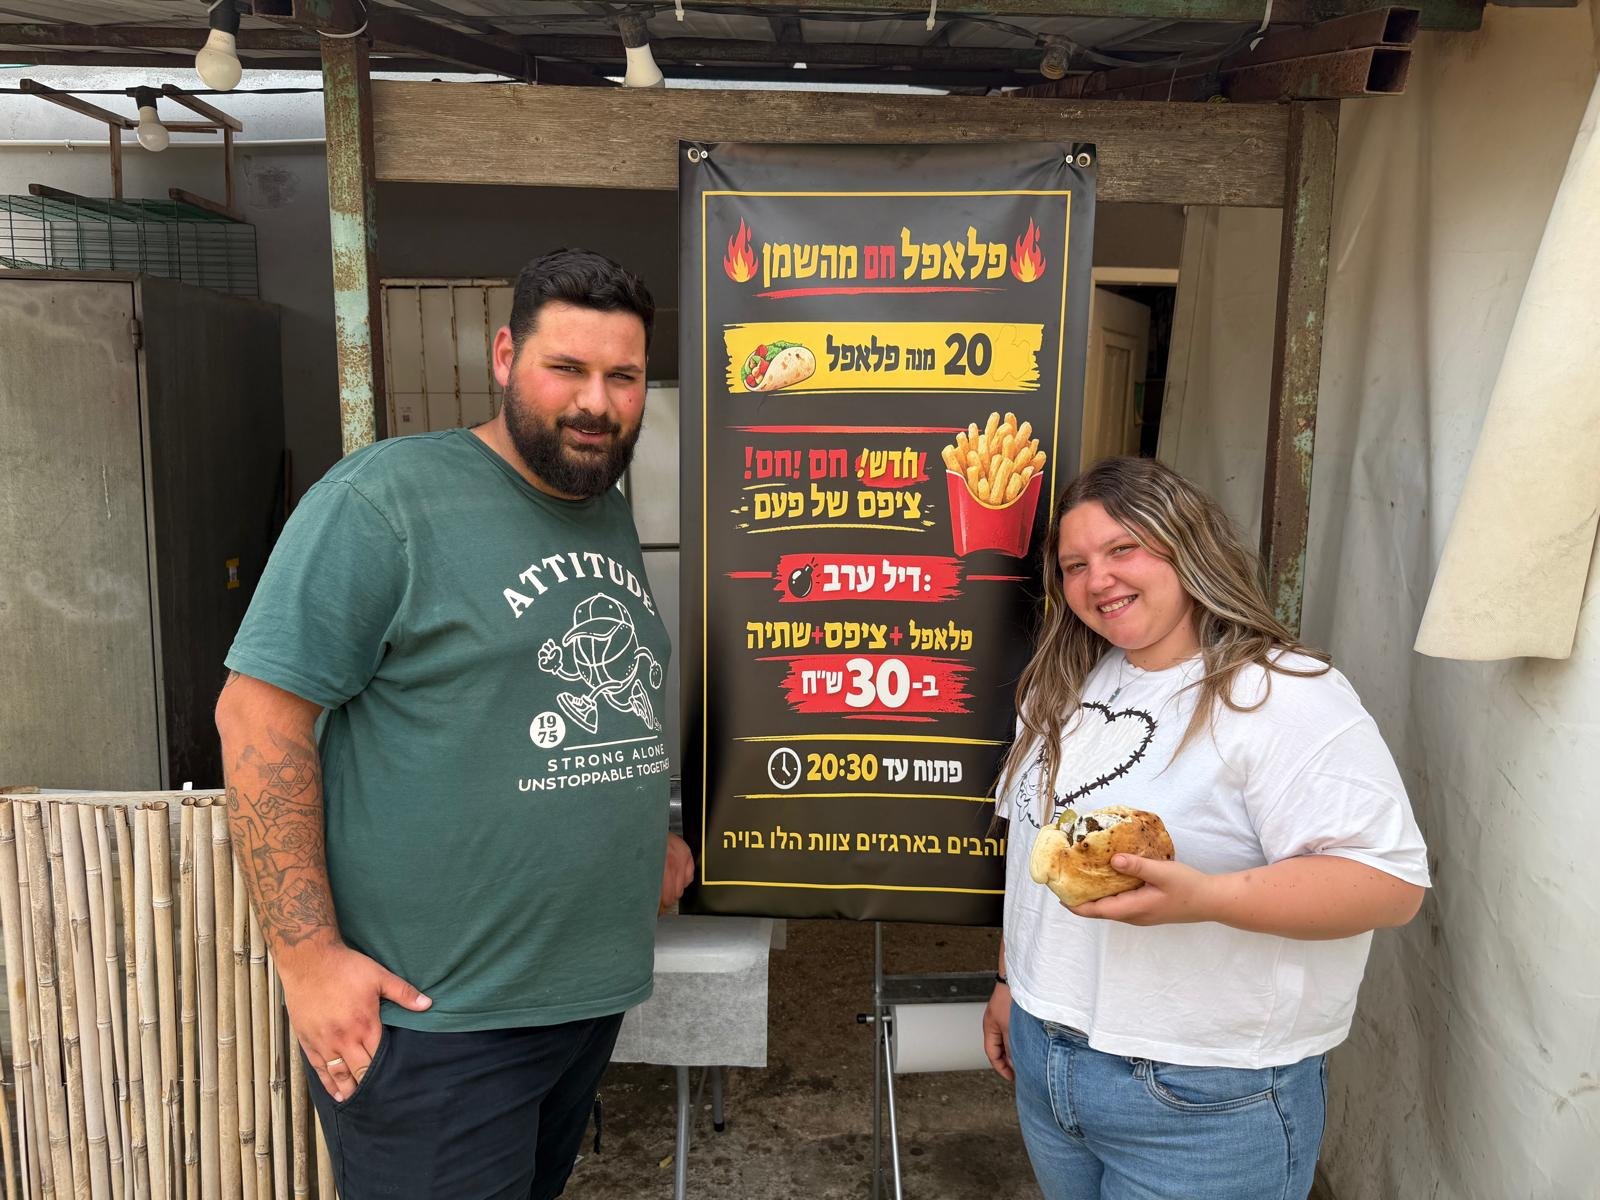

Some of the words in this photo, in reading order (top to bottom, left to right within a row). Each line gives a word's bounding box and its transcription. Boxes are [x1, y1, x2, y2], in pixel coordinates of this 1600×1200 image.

[762, 242, 858, 289] מהשמן
[863, 245, 896, 280] חם
[900, 226, 1007, 281] פלאפל
[826, 334, 900, 372] פלאפל
[905, 347, 936, 371] מנה
[944, 332, 992, 376] 20
[808, 448, 848, 480] חם
[753, 491, 805, 520] פעם
[810, 482, 849, 518] של
[503, 551, 655, 618] ATTITUDE
[822, 564, 876, 593] ערב
[908, 618, 973, 651] פלאפל
[538, 715, 557, 730] 19
[537, 730, 558, 745] 75
[547, 750, 625, 773] STRONG
[632, 743, 665, 761] ALONE
[806, 753, 879, 782] 20:30
[882, 757, 909, 782] עד
[913, 759, 963, 783] פתוח
[518, 765, 634, 793] UNSTOPPABLE
[723, 830, 765, 849] בויה
[770, 825, 803, 850] הלו
[808, 832, 851, 852] צוות
[856, 833, 942, 855] בארגזים
[947, 836, 1005, 857] והבים
